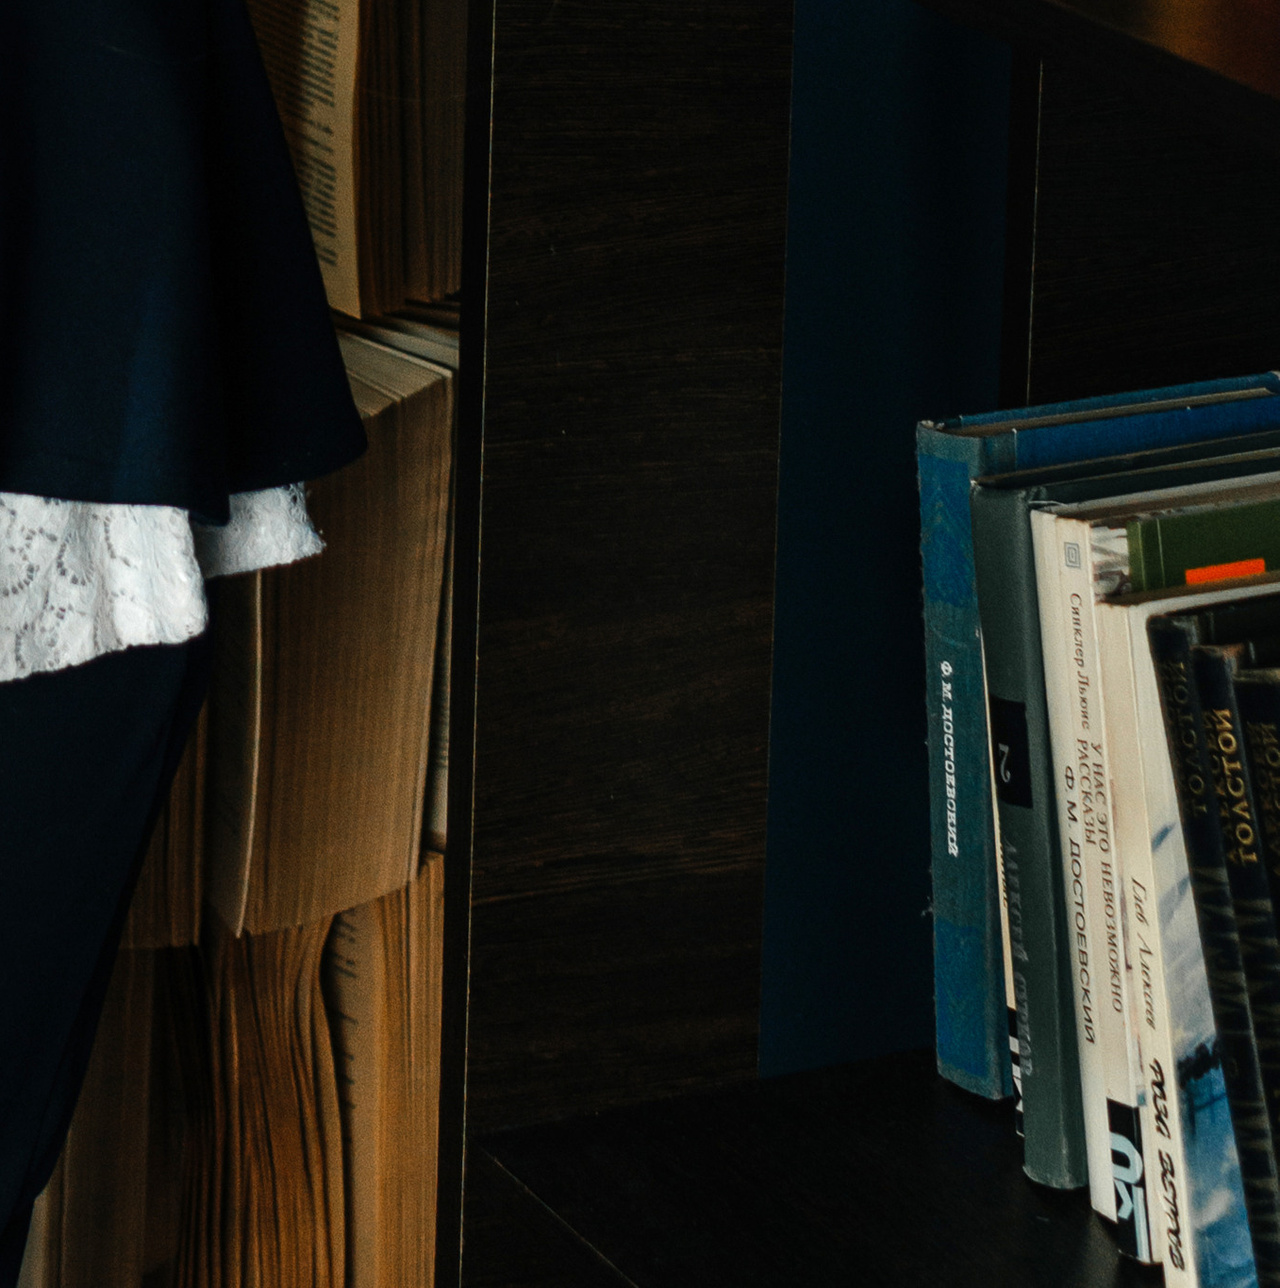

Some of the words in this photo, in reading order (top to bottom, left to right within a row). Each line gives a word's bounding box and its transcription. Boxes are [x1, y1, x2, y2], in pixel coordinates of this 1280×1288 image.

[1069, 592, 1086, 668] Синклер
[940, 660, 954, 678] Ф.
[941, 681, 953, 702] М.
[1076, 670, 1091, 731] Льюис
[1064, 766, 1075, 791] Ф.
[1090, 742, 1102, 756] У
[941, 703, 960, 859] ДОСТОЕВСКИЙ
[1077, 738, 1097, 845] РАССКАЗЫ
[1092, 761, 1106, 808] НАС
[1211, 708, 1258, 867] ТОЛСТОЙ
[1066, 799, 1078, 828] М.
[1096, 812, 1110, 853] ЭТО
[1131, 876, 1150, 927] Глеб
[1069, 837, 1097, 1045] ДОСТОЕВСКИЙ
[1101, 860, 1123, 1014] НЕВОЗМОЖНО
[1138, 932, 1157, 1030] Алексеев
[1158, 1148, 1186, 1273] ВЕТРОВ
